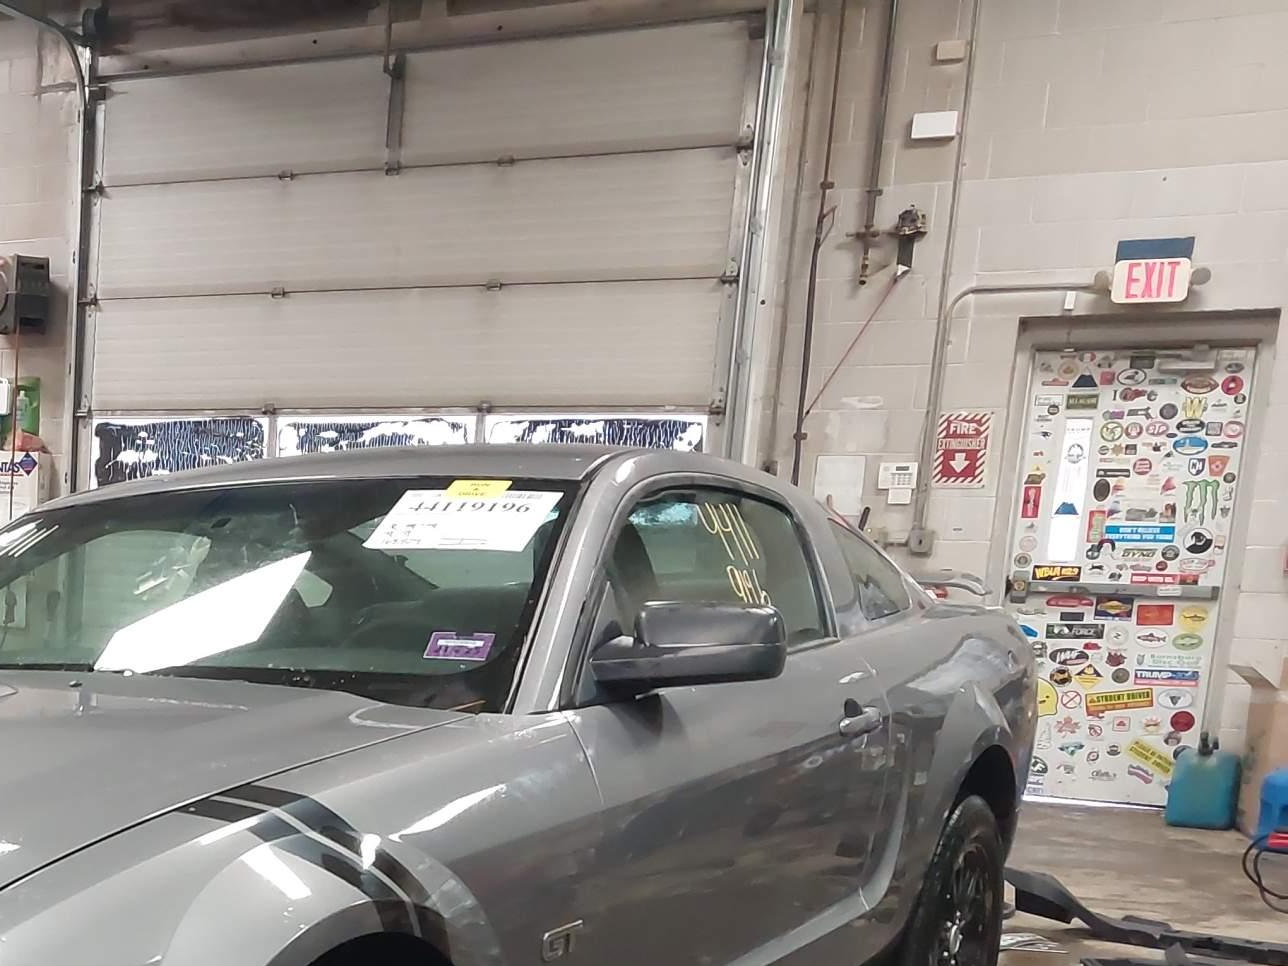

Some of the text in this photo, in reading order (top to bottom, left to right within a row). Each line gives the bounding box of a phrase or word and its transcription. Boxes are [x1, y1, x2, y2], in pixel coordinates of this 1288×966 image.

[1125, 261, 1181, 299] EXIT
[949, 422, 977, 435] FIRE
[408, 501, 531, 513] 44119196
[542, 919, 583, 961] GT
